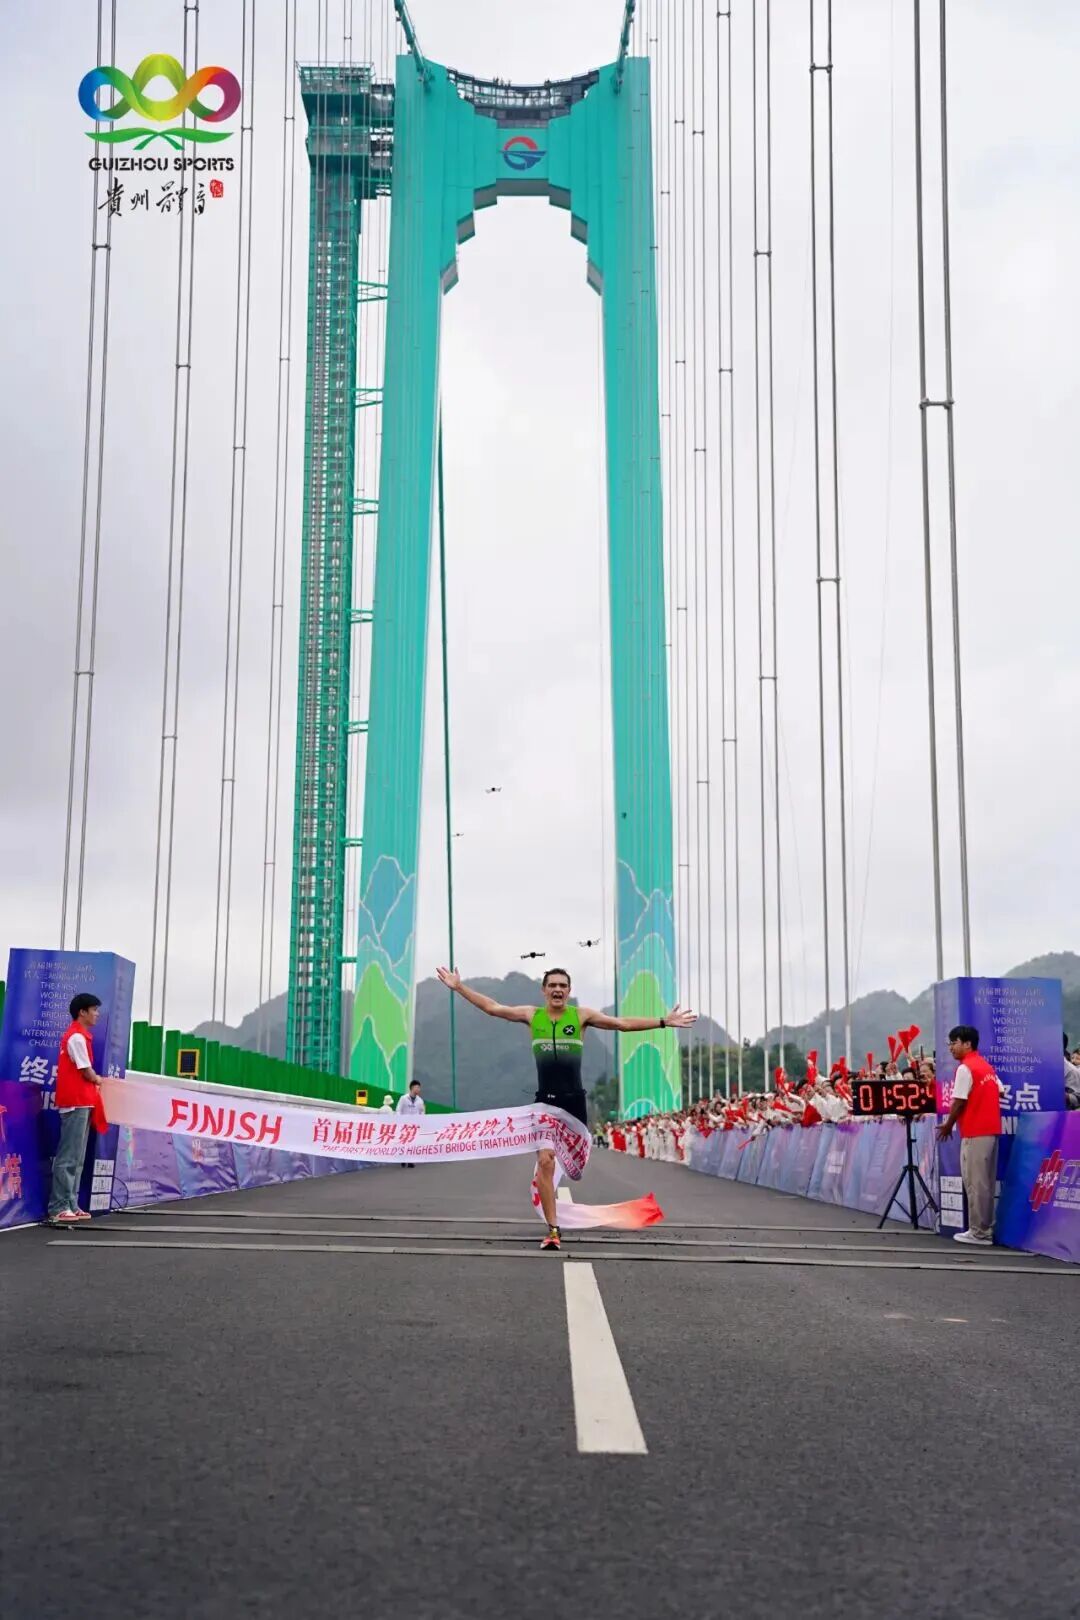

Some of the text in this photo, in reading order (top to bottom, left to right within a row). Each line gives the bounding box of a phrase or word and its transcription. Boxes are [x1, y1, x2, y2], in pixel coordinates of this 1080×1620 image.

[19, 1056, 58, 1085] 终
[167, 1098, 283, 1145] FINISH
[321, 1144, 340, 1152] THE
[341, 1145, 364, 1154] FIRST
[366, 1145, 405, 1156] WORLD'S
[406, 1143, 444, 1156] HIGHEST
[445, 1140, 477, 1154] BRIDGE
[479, 1134, 527, 1150] TRIATHLON
